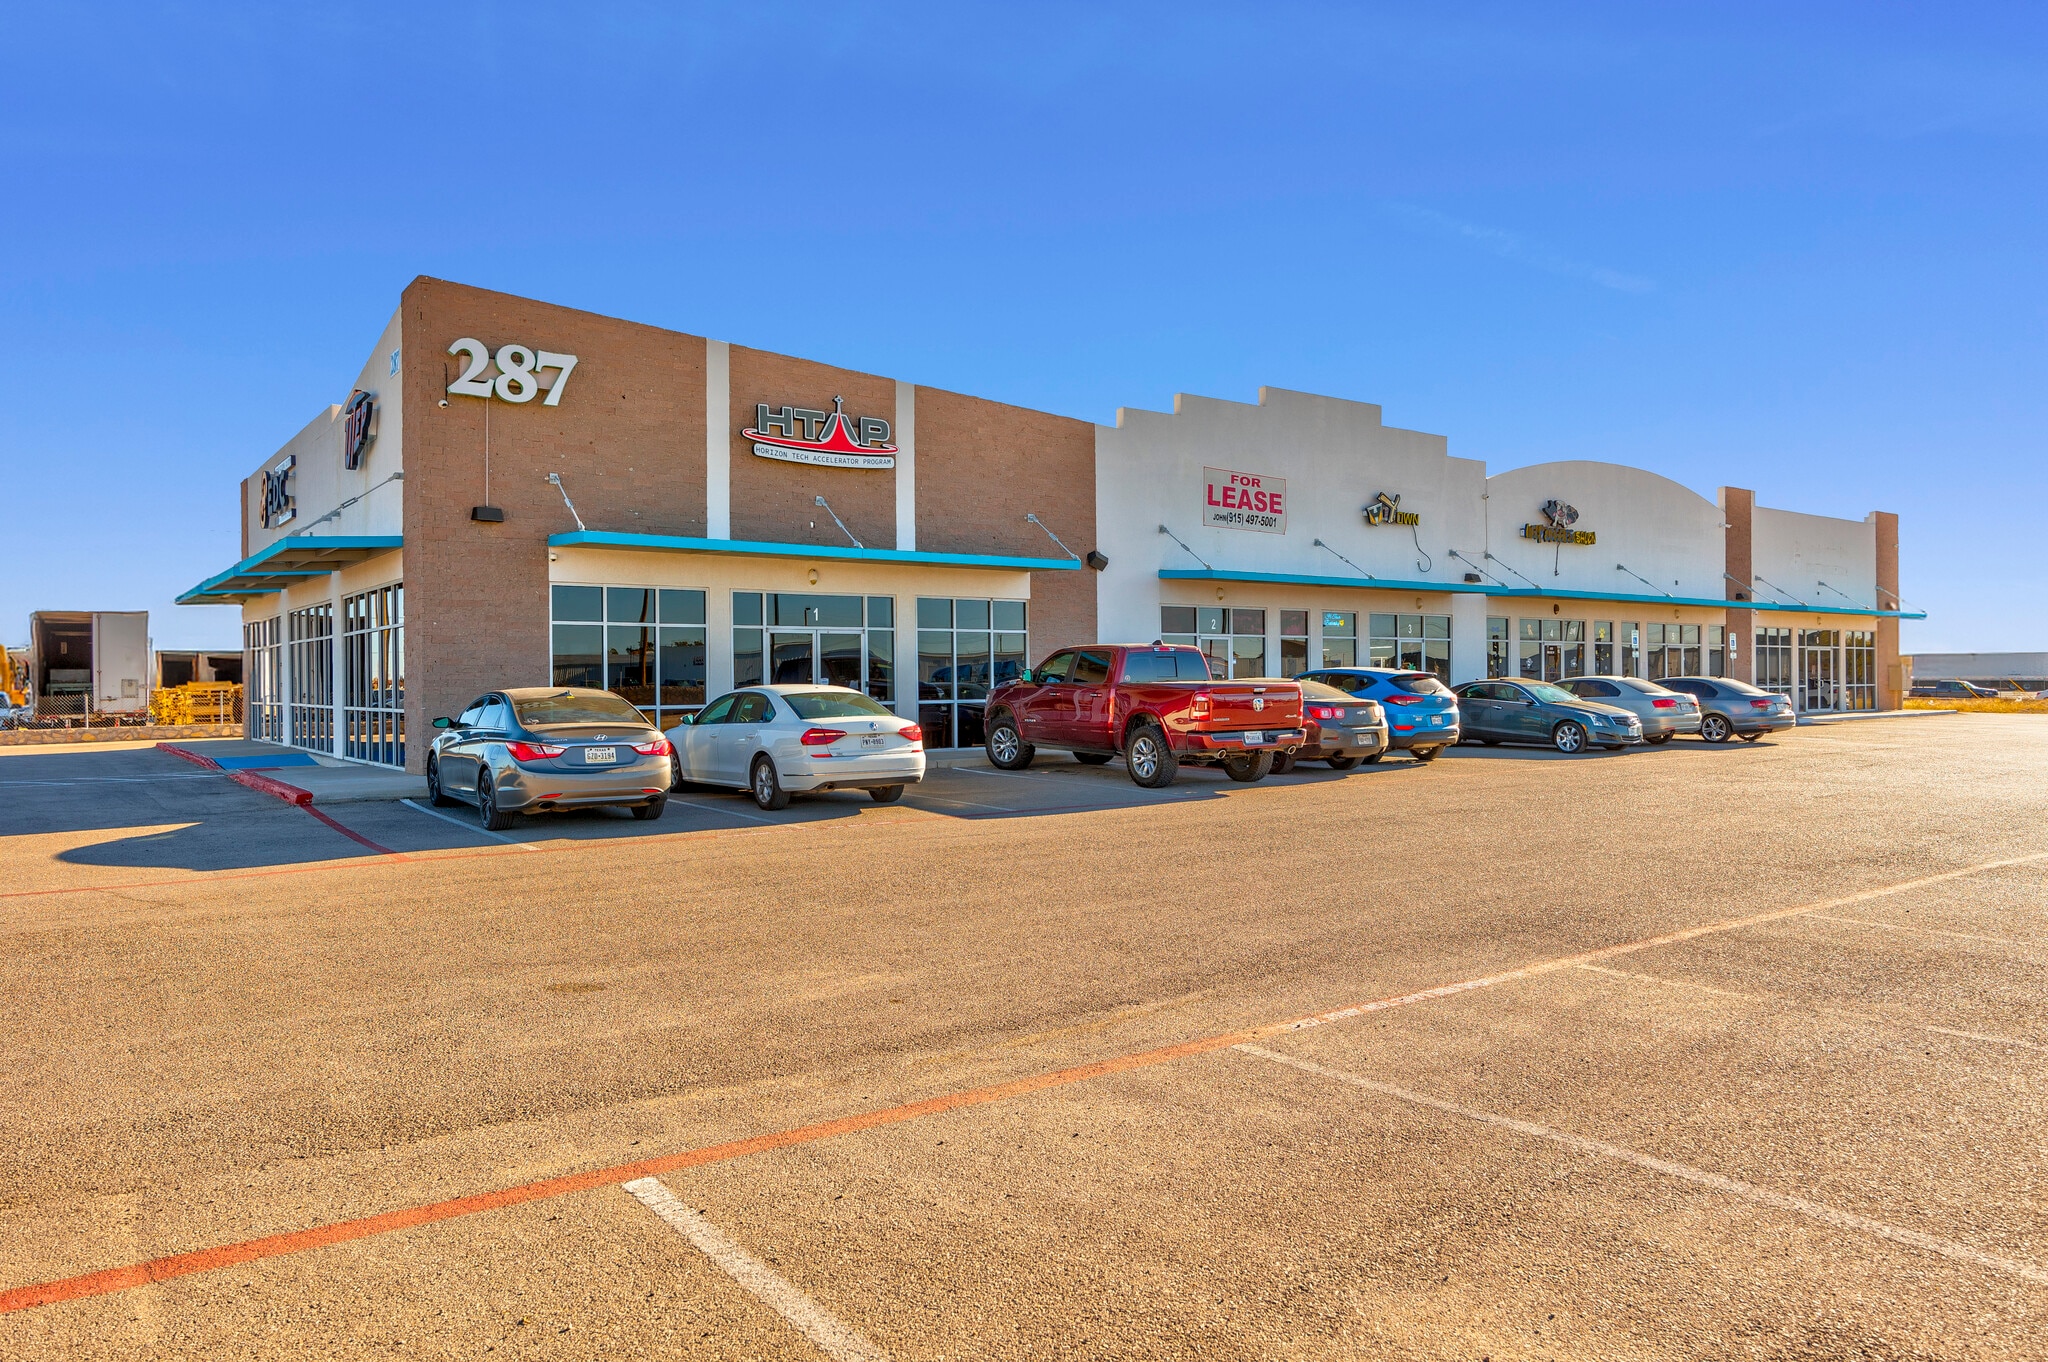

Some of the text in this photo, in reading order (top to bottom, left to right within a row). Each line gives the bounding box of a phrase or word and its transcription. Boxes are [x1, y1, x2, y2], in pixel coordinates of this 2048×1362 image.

[447, 337, 579, 406] 287
[756, 446, 788, 458] HORIZON
[791, 452, 809, 461] TECH
[812, 455, 859, 465] ACCELERATOR
[1230, 474, 1261, 488] FOR
[1207, 484, 1283, 514] LEASE
[1245, 513, 1277, 528] 497-5001
[813, 607, 819, 621] 1
[1211, 618, 1216, 630] 2
[1408, 623, 1412, 634] 3
